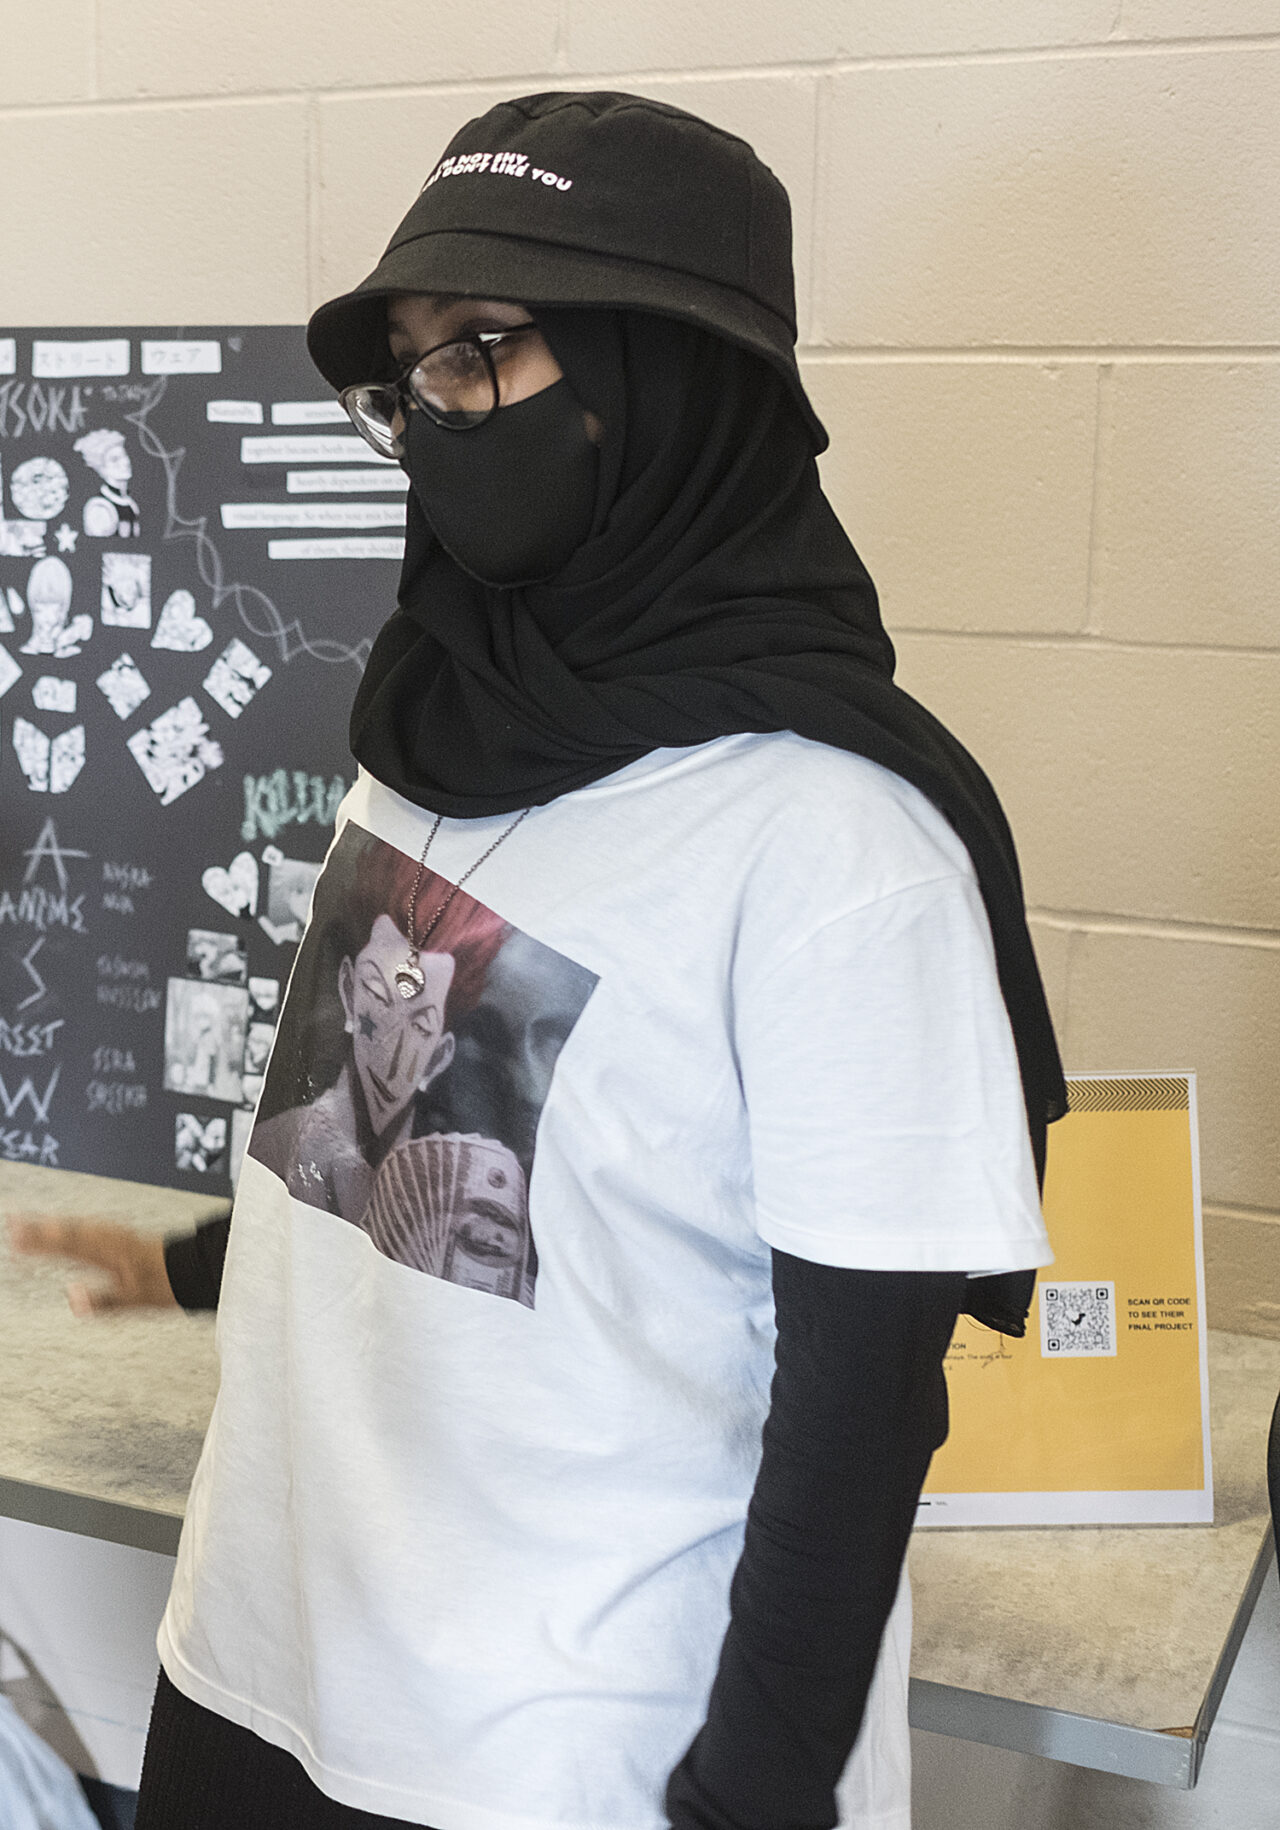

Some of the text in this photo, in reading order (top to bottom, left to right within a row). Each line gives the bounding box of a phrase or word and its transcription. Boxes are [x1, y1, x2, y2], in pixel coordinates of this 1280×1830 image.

[458, 152, 494, 166] NOT
[441, 162, 573, 192] DON'T LIKE YOU
[38, 350, 117, 370] ストリート
[149, 347, 202, 365] ウェア
[23, 815, 91, 891] A
[17, 936, 48, 1012] S
[1127, 1298, 1191, 1306] SCAN QR CODE
[1160, 1310, 1184, 1318] THEIR
[1128, 1323, 1193, 1331] FINAL PROJECT
